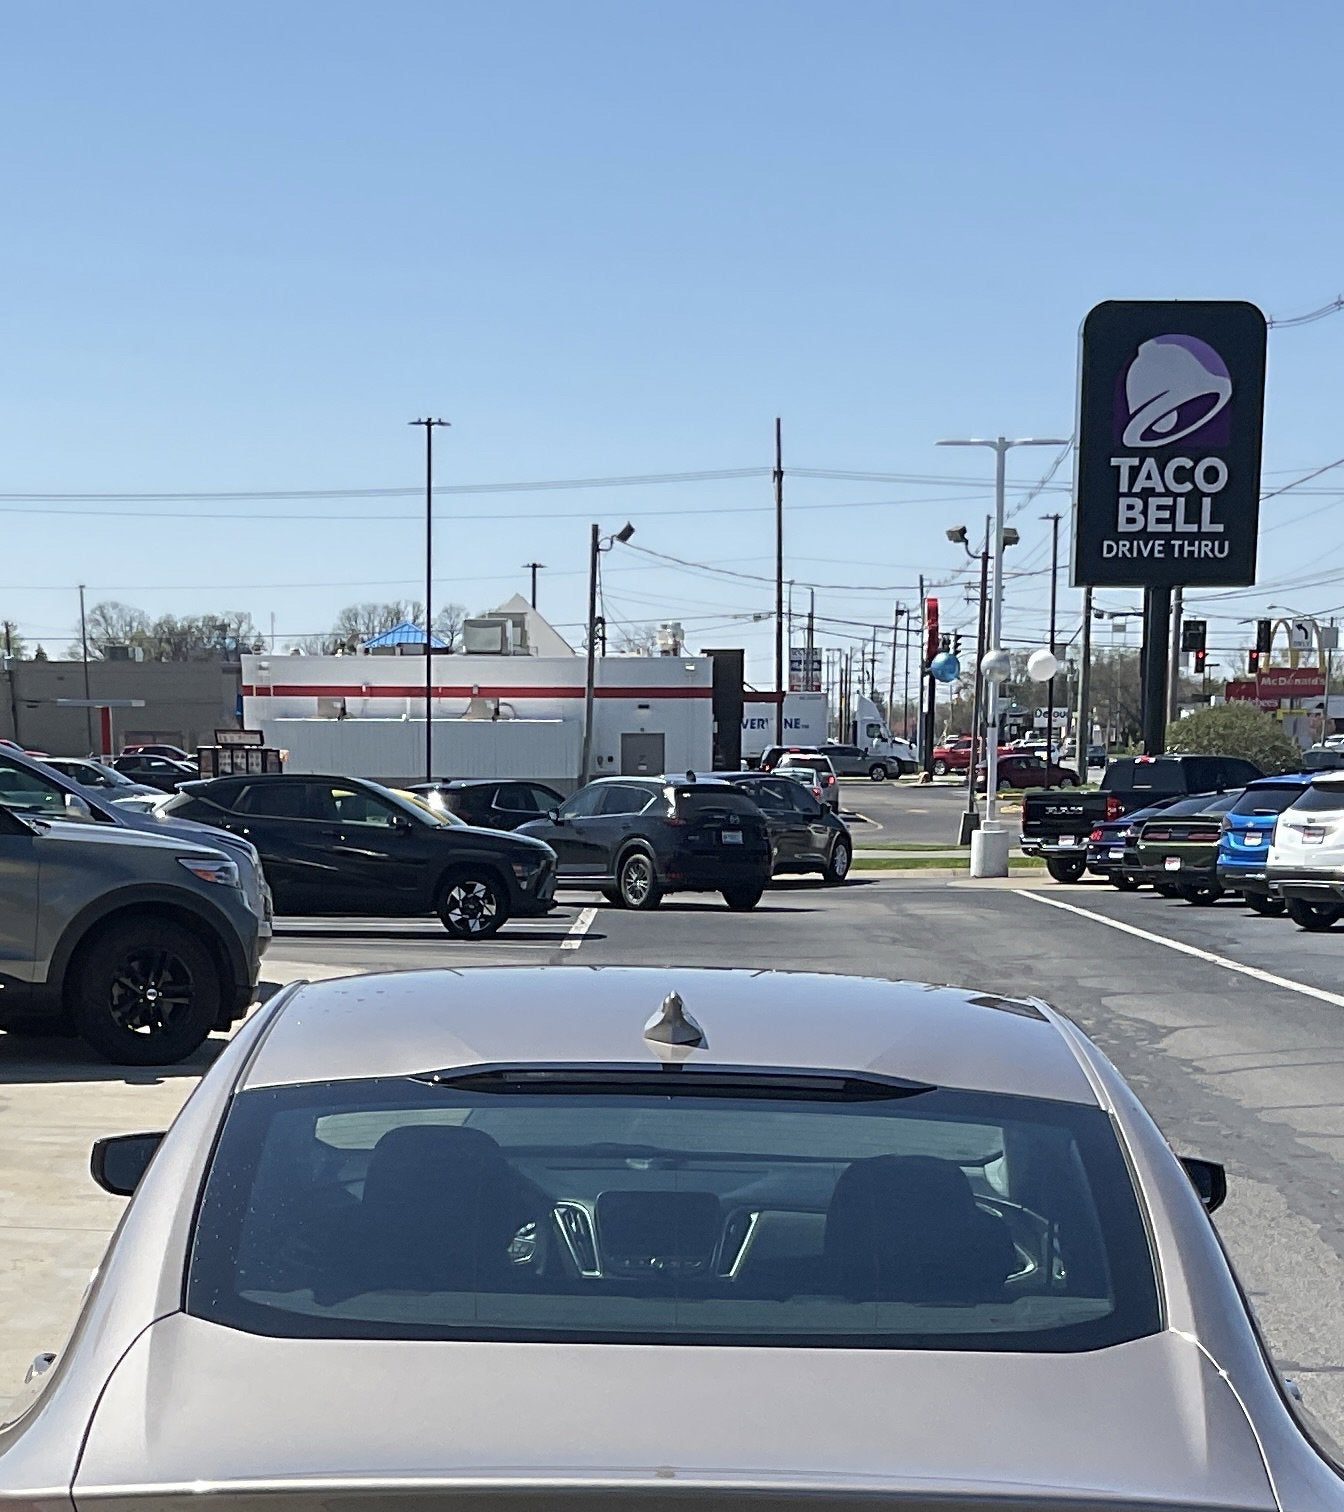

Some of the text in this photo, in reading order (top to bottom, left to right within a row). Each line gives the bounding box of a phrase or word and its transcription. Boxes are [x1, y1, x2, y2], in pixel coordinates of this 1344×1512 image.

[1110, 457, 1228, 493] TACO
[1117, 497, 1224, 532] BELL
[1103, 540, 1229, 558] DRIVE THRU
[1260, 675, 1326, 686] McDonald's
